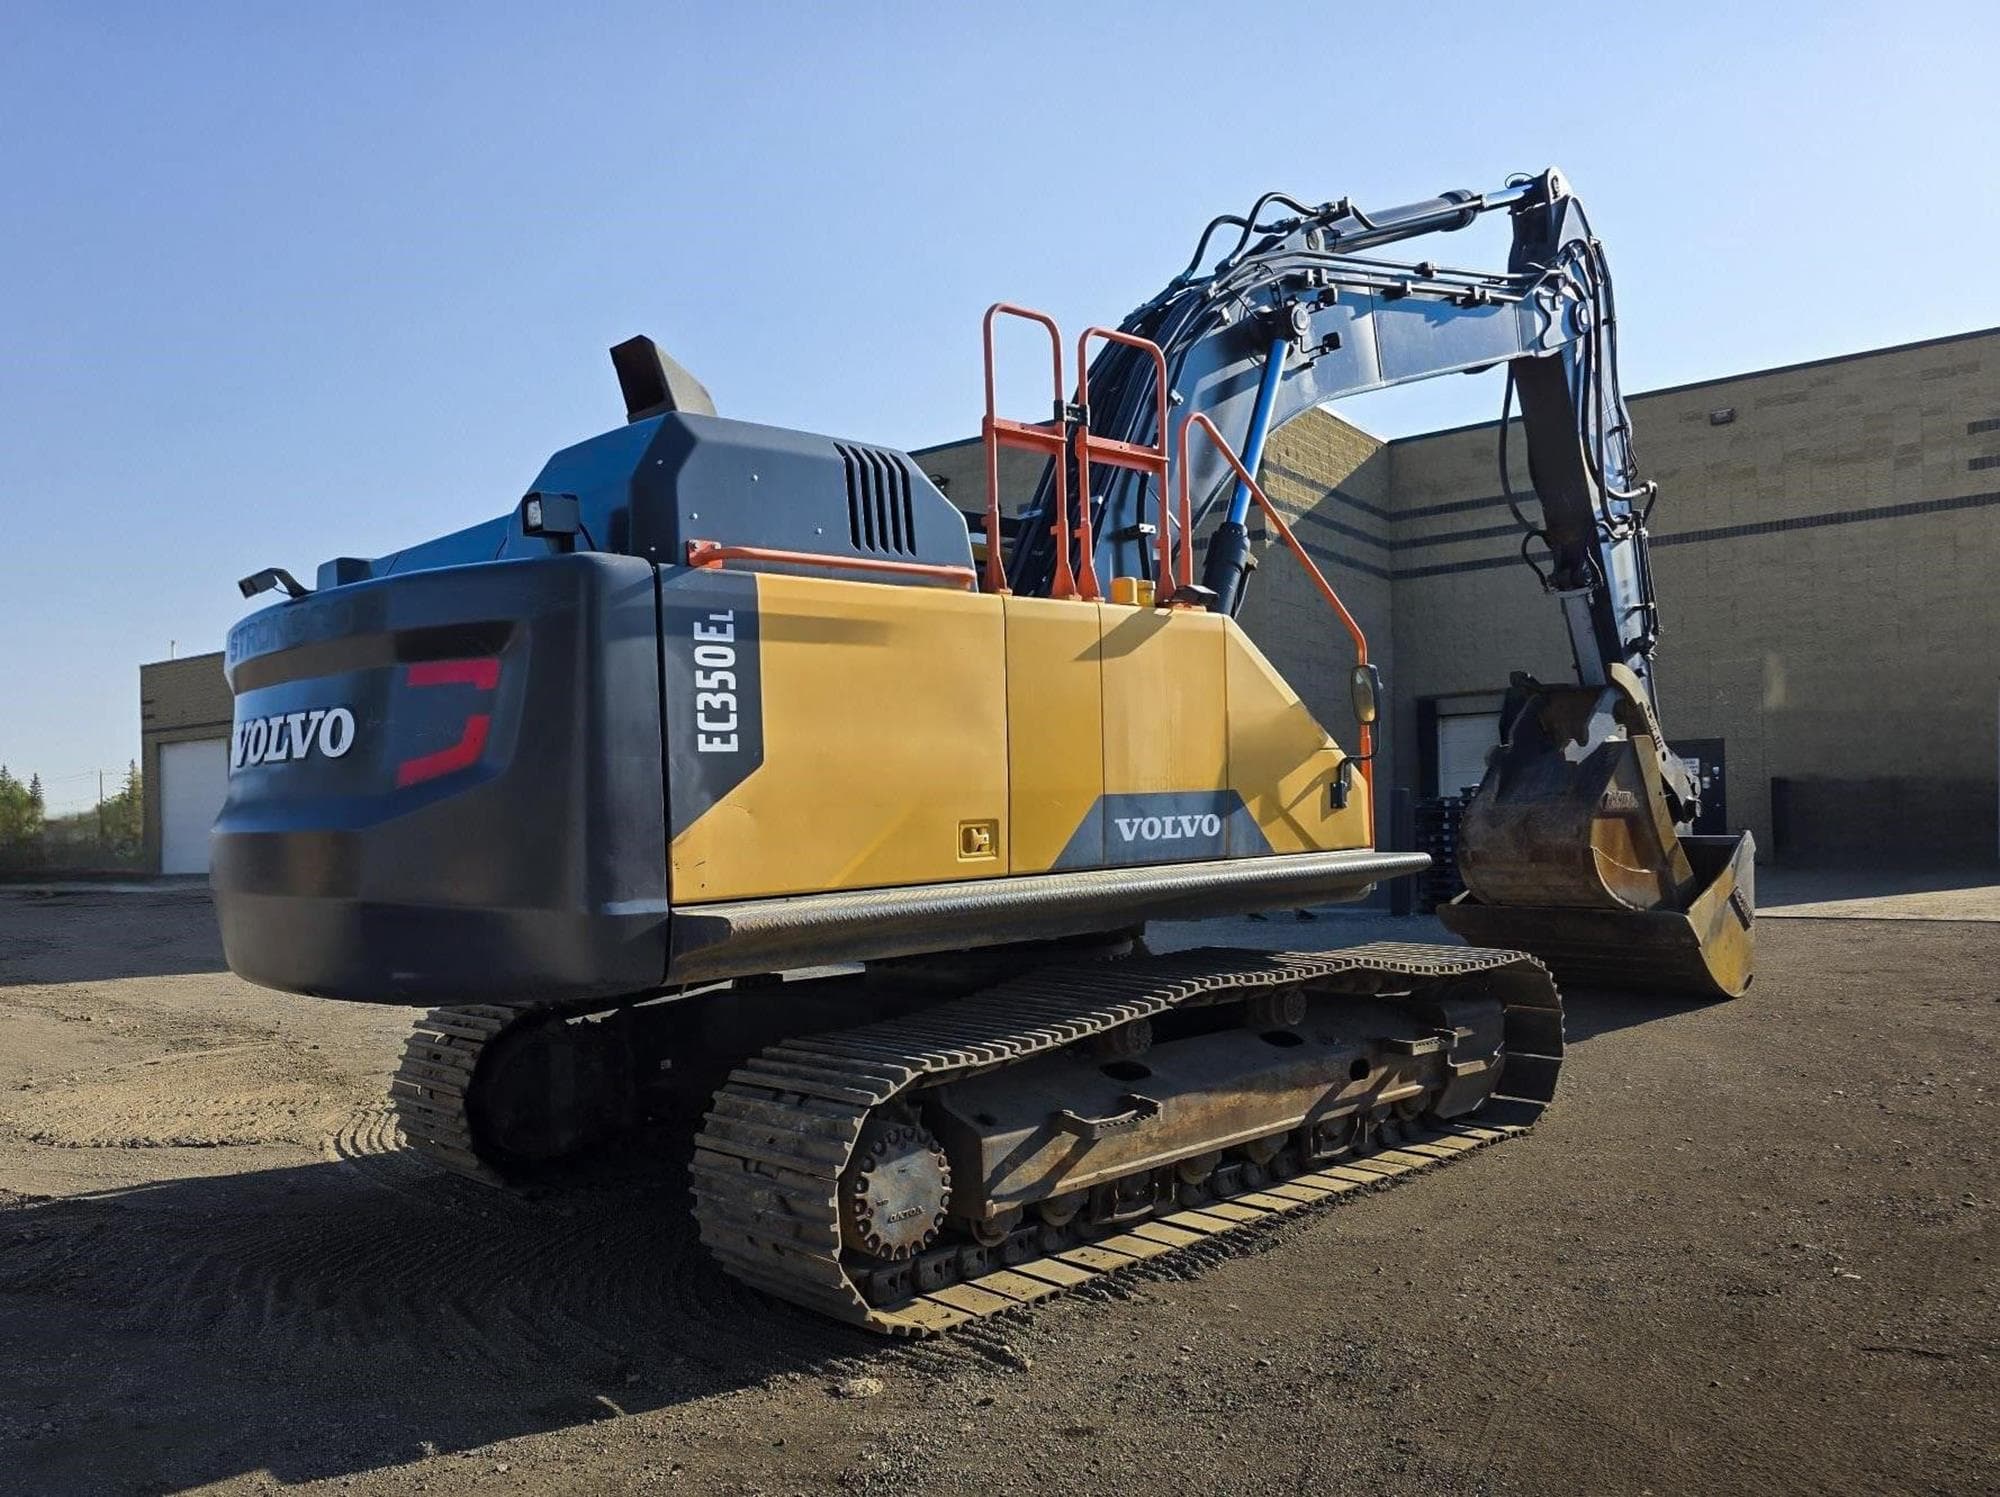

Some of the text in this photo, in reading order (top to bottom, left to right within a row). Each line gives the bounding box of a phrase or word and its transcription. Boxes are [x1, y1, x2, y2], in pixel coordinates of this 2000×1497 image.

[693, 609, 739, 752] EC350EL
[231, 707, 355, 768] VOLVO
[1115, 813, 1221, 842] VOLVO
